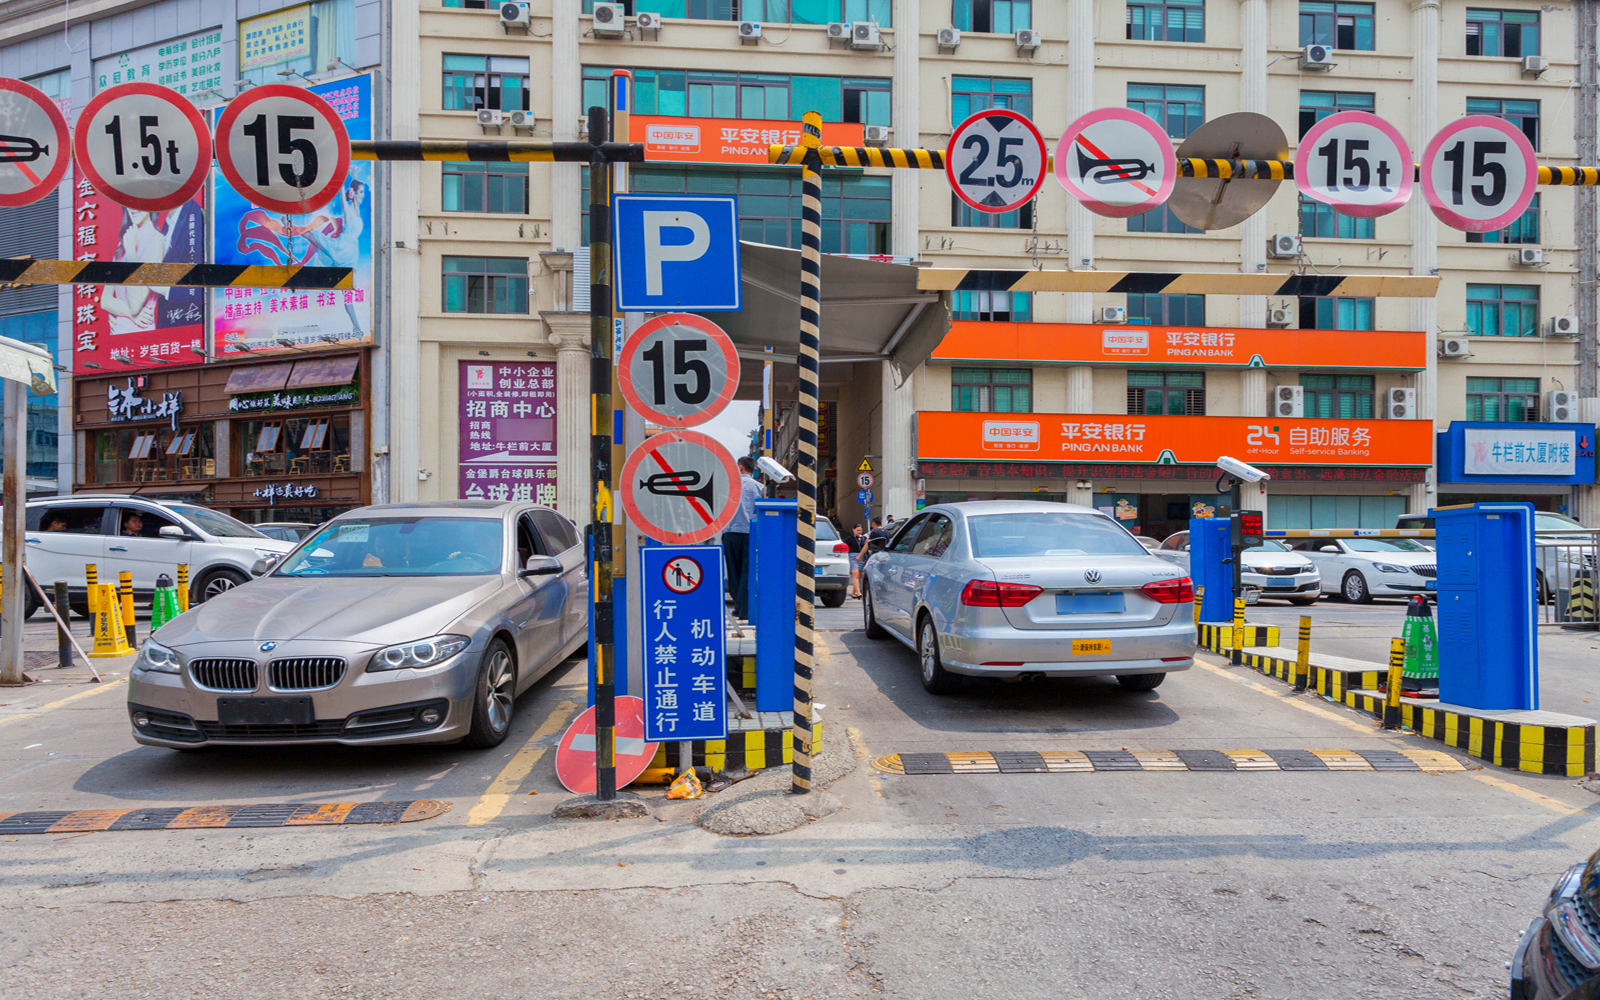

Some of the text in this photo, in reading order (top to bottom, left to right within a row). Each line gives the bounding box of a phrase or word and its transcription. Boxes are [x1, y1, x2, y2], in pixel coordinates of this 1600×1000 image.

[652, 131, 694, 141] 中国平安
[720, 127, 801, 147] 平安银行
[105, 115, 181, 176] 1.5t
[243, 114, 319, 188] 15
[1444, 141, 1507, 207] 15
[643, 210, 711, 296] P
[224, 300, 262, 320] 播音主持
[269, 294, 308, 314] 美术素描
[316, 291, 336, 308] 书法
[1108, 336, 1144, 344] 中国平安
[1166, 331, 1235, 347] 平安银行
[1208, 349, 1234, 357] BANK
[499, 366, 554, 377] 中小企业
[643, 339, 711, 406] 15
[499, 378, 554, 389] 创业总部
[466, 400, 556, 418] 招商中心
[469, 421, 491, 430] 招商
[989, 427, 1033, 437] 中国平安
[1061, 422, 1146, 440] 平安银行
[469, 431, 491, 440] 热线
[1247, 425, 1371, 446] 24 自助服务
[1112, 444, 1143, 452] BANK
[1289, 447, 1370, 457] Self-service Banking
[1492, 441, 1569, 463] 牛栏前大厦附楼
[465, 468, 557, 479] 金堡爵台球俱乐部
[861, 476, 870, 486] 15
[465, 482, 557, 506] 台球棋牌
[653, 599, 679, 732] 行人禁止通行
[690, 619, 716, 722] 机动车道
